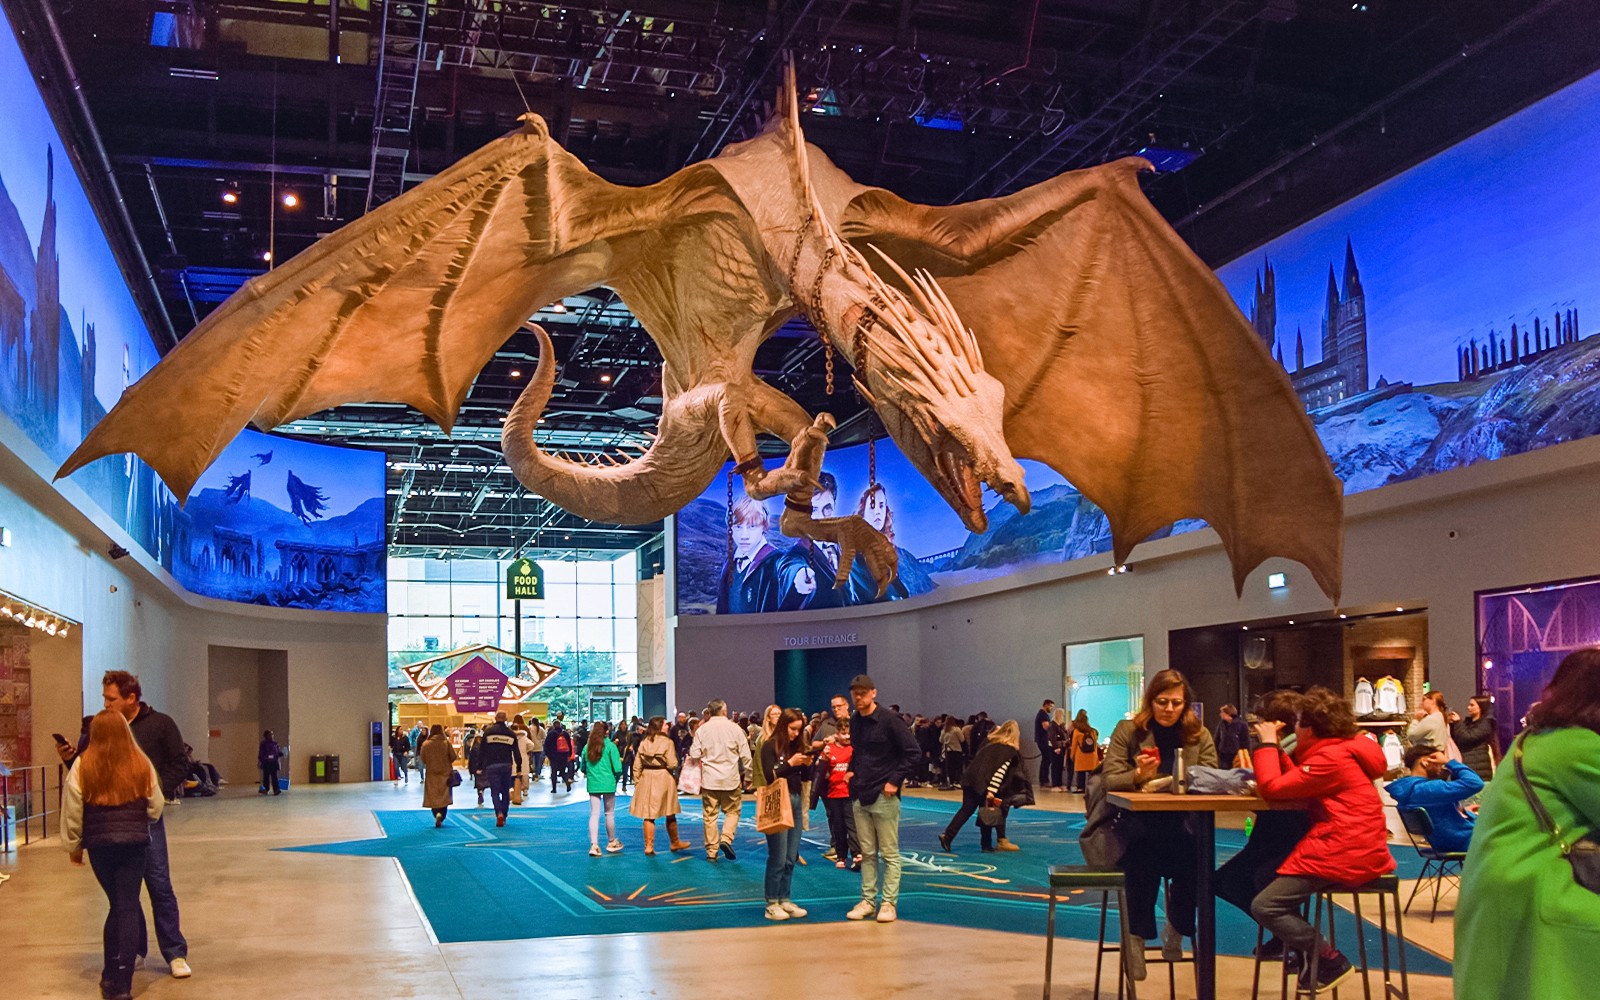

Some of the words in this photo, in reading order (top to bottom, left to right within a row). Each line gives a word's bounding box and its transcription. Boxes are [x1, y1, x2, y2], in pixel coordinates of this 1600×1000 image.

[514, 576, 538, 585] FOOD
[515, 586, 538, 595] HALL
[784, 636, 809, 646] TOUR
[812, 633, 857, 645] ENTRANCE
